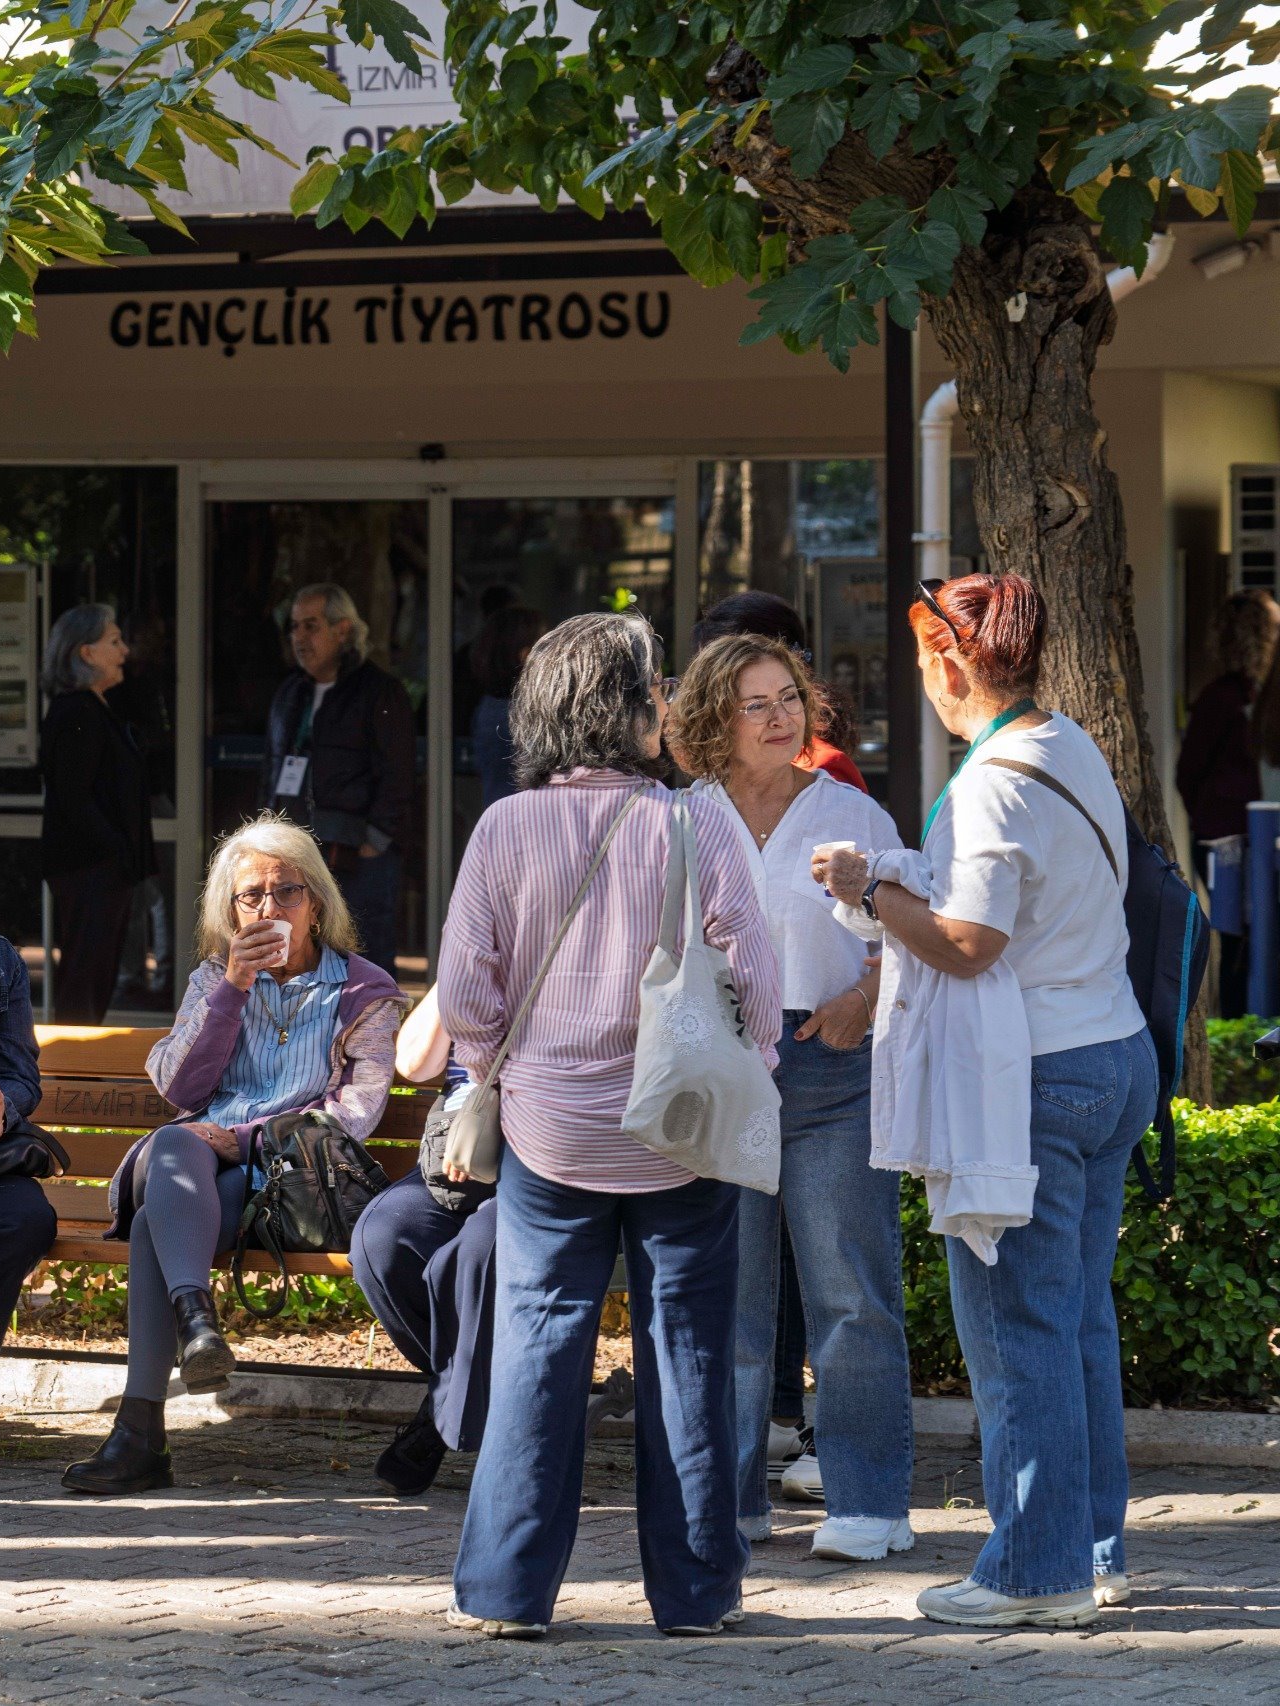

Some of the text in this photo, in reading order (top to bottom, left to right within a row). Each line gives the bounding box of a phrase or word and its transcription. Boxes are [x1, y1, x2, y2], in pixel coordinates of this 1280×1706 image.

[109, 284, 671, 358] GENÇLİK TİYATROSU
[55, 1086, 136, 1117] İZMİR
